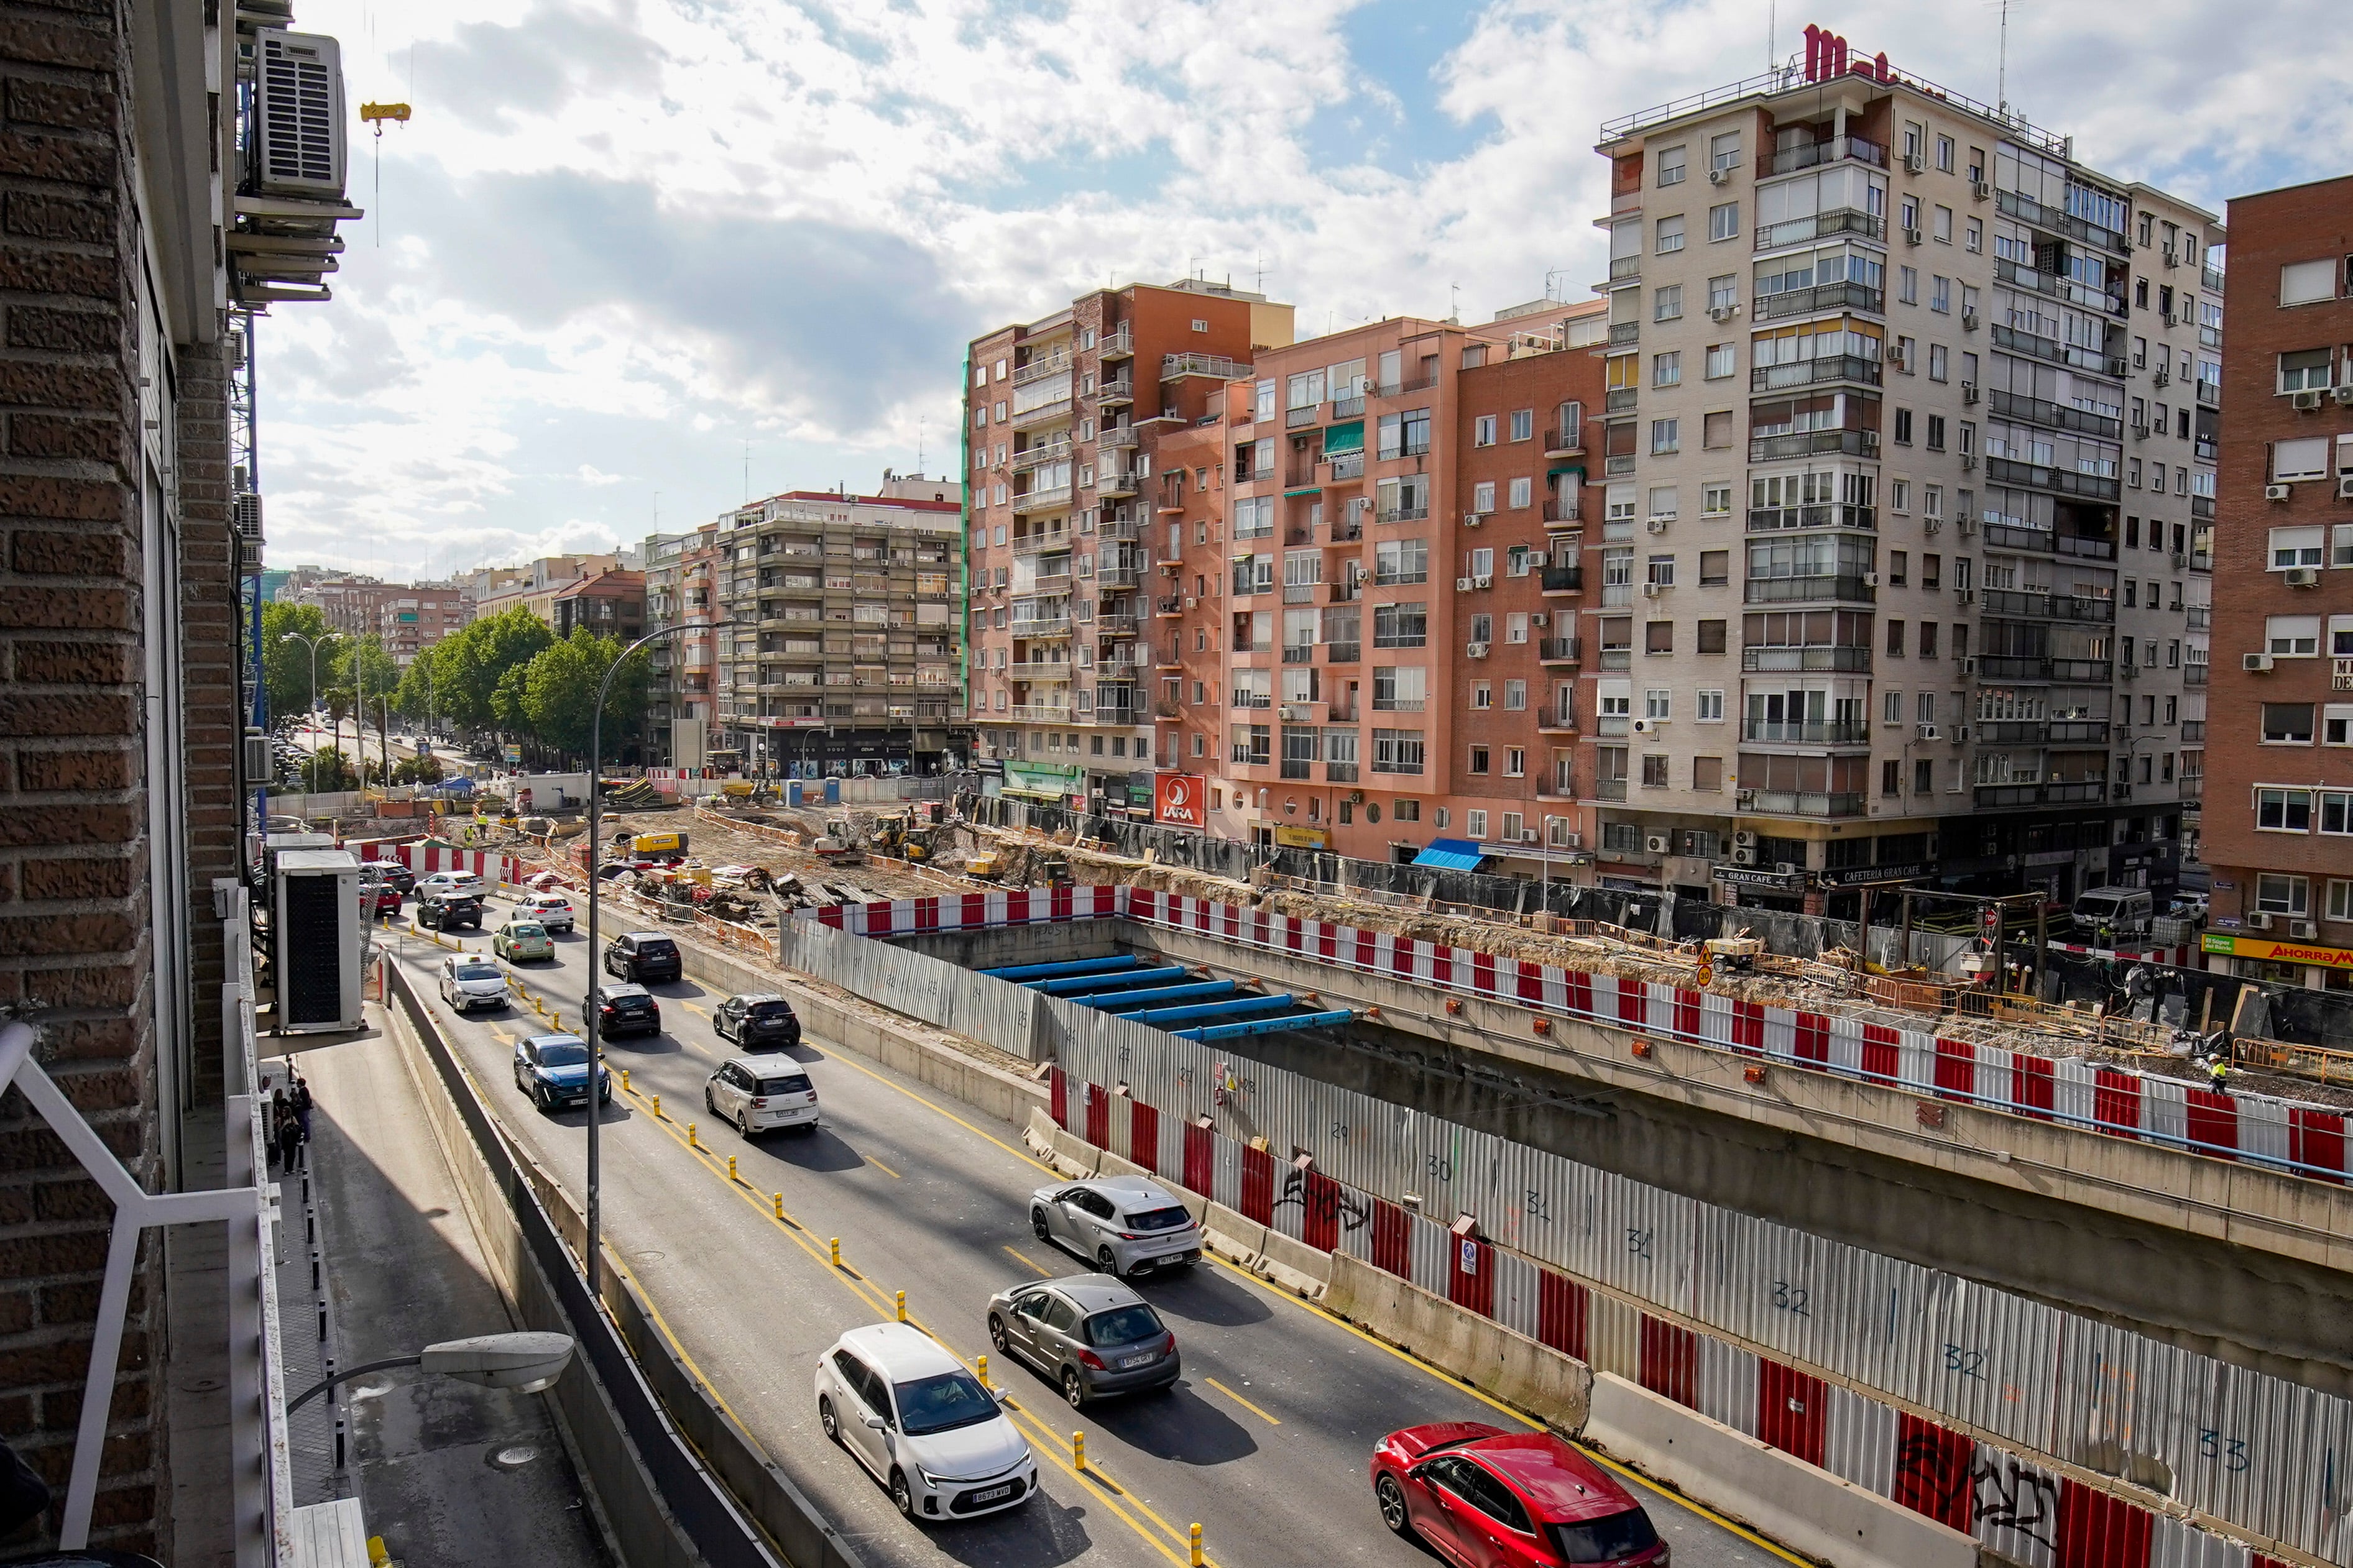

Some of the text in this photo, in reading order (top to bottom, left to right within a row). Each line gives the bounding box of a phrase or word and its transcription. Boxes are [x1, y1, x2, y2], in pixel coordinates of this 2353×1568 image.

[1163, 805, 1194, 820] LARA
[1728, 872, 1772, 884] GRAN CAFÉ
[1844, 863, 1920, 883] CAFETERÍA GRAN CAFÉ
[1244, 1078, 1255, 1094] 28
[1332, 1122, 1348, 1146] 29
[1429, 1155, 1451, 1181] 30
[1526, 1190, 1551, 1222] 31
[1774, 1281, 1810, 1318] 32
[2200, 1428, 2248, 1471] 33
[978, 1487, 1009, 1501] 8673 MVD
